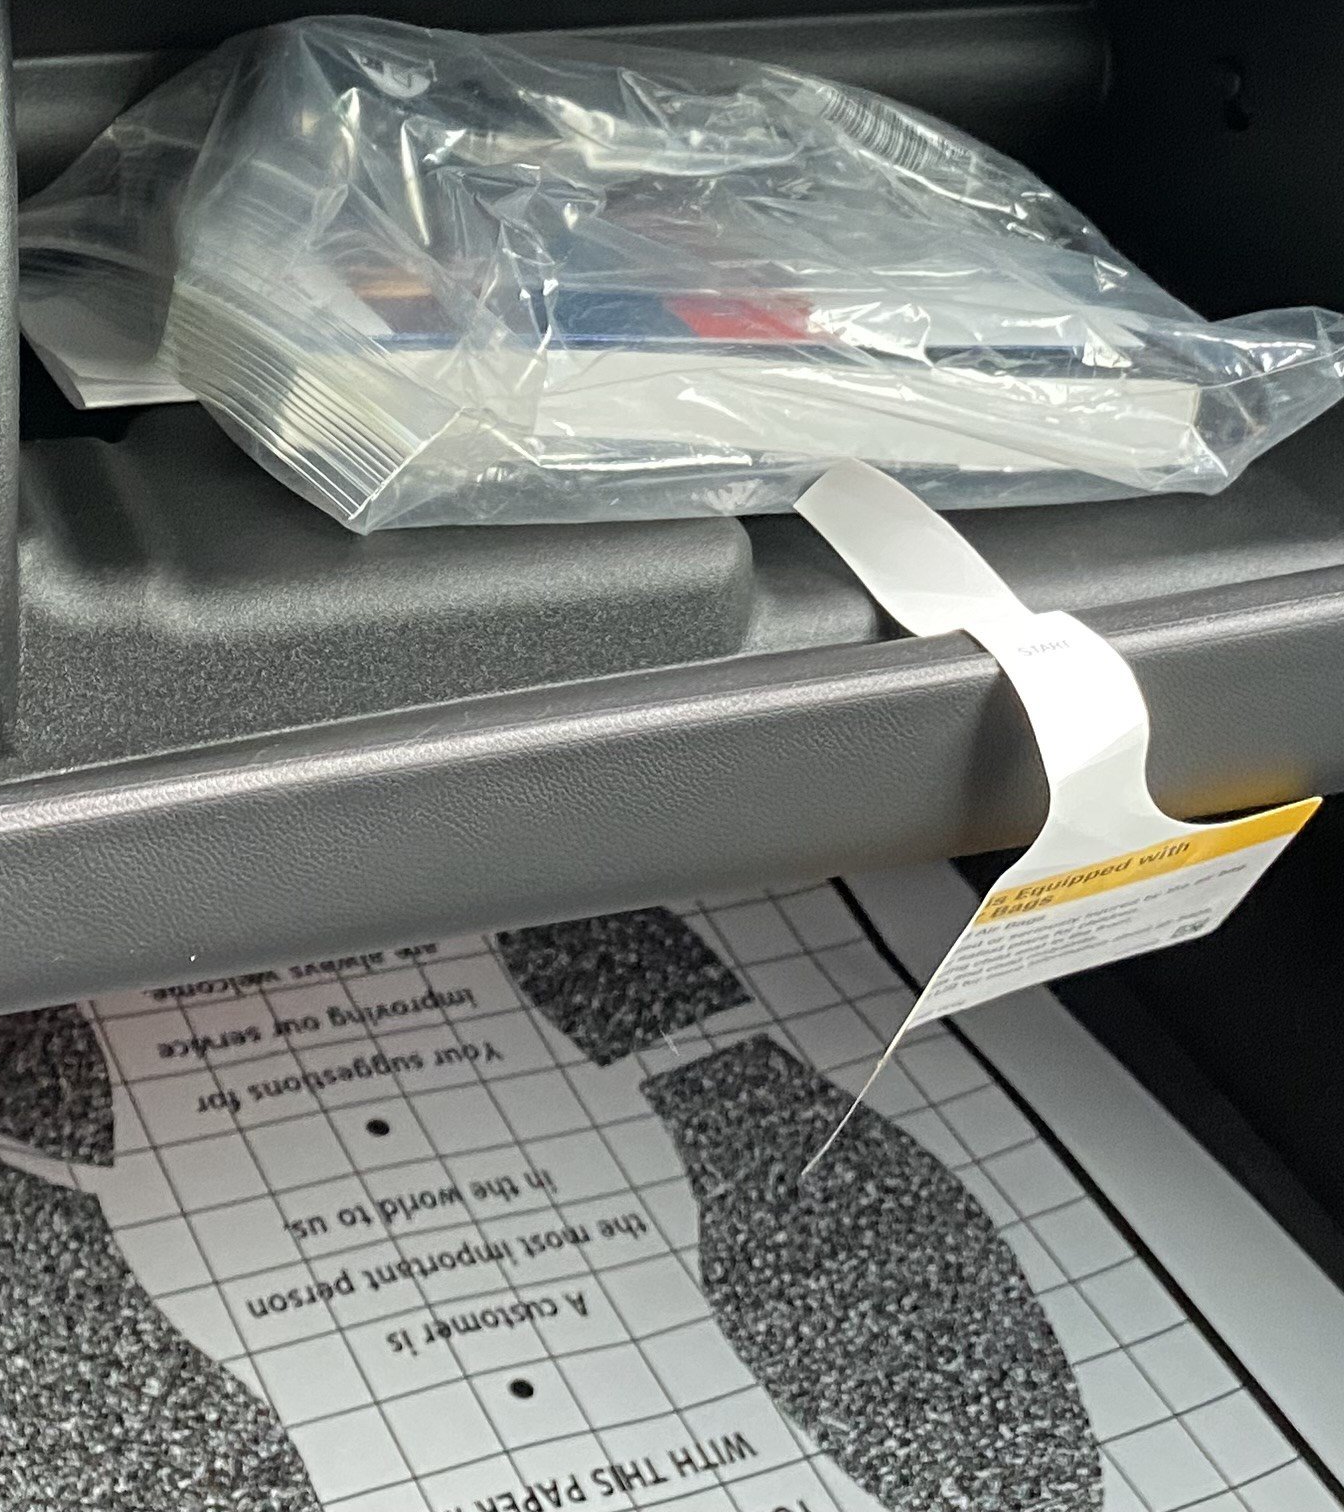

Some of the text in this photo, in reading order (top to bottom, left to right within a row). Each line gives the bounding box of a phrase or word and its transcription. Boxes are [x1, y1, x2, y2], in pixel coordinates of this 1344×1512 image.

[1017, 639, 1071, 657] START
[1014, 857, 1133, 900] Equipped
[1139, 841, 1191, 865] with
[991, 894, 1055, 918] Bags
[157, 986, 477, 1059] improving our service
[195, 1040, 504, 1115] Your suggestions for
[473, 1174, 520, 1200] the
[524, 1169, 556, 1191] in
[338, 1203, 372, 1227] to
[379, 1184, 465, 1224] world
[244, 1212, 648, 1319] the most important person
[385, 1290, 591, 1357] A customer is
[667, 1430, 759, 1479] WITH
[590, 1456, 668, 1498] THIS
